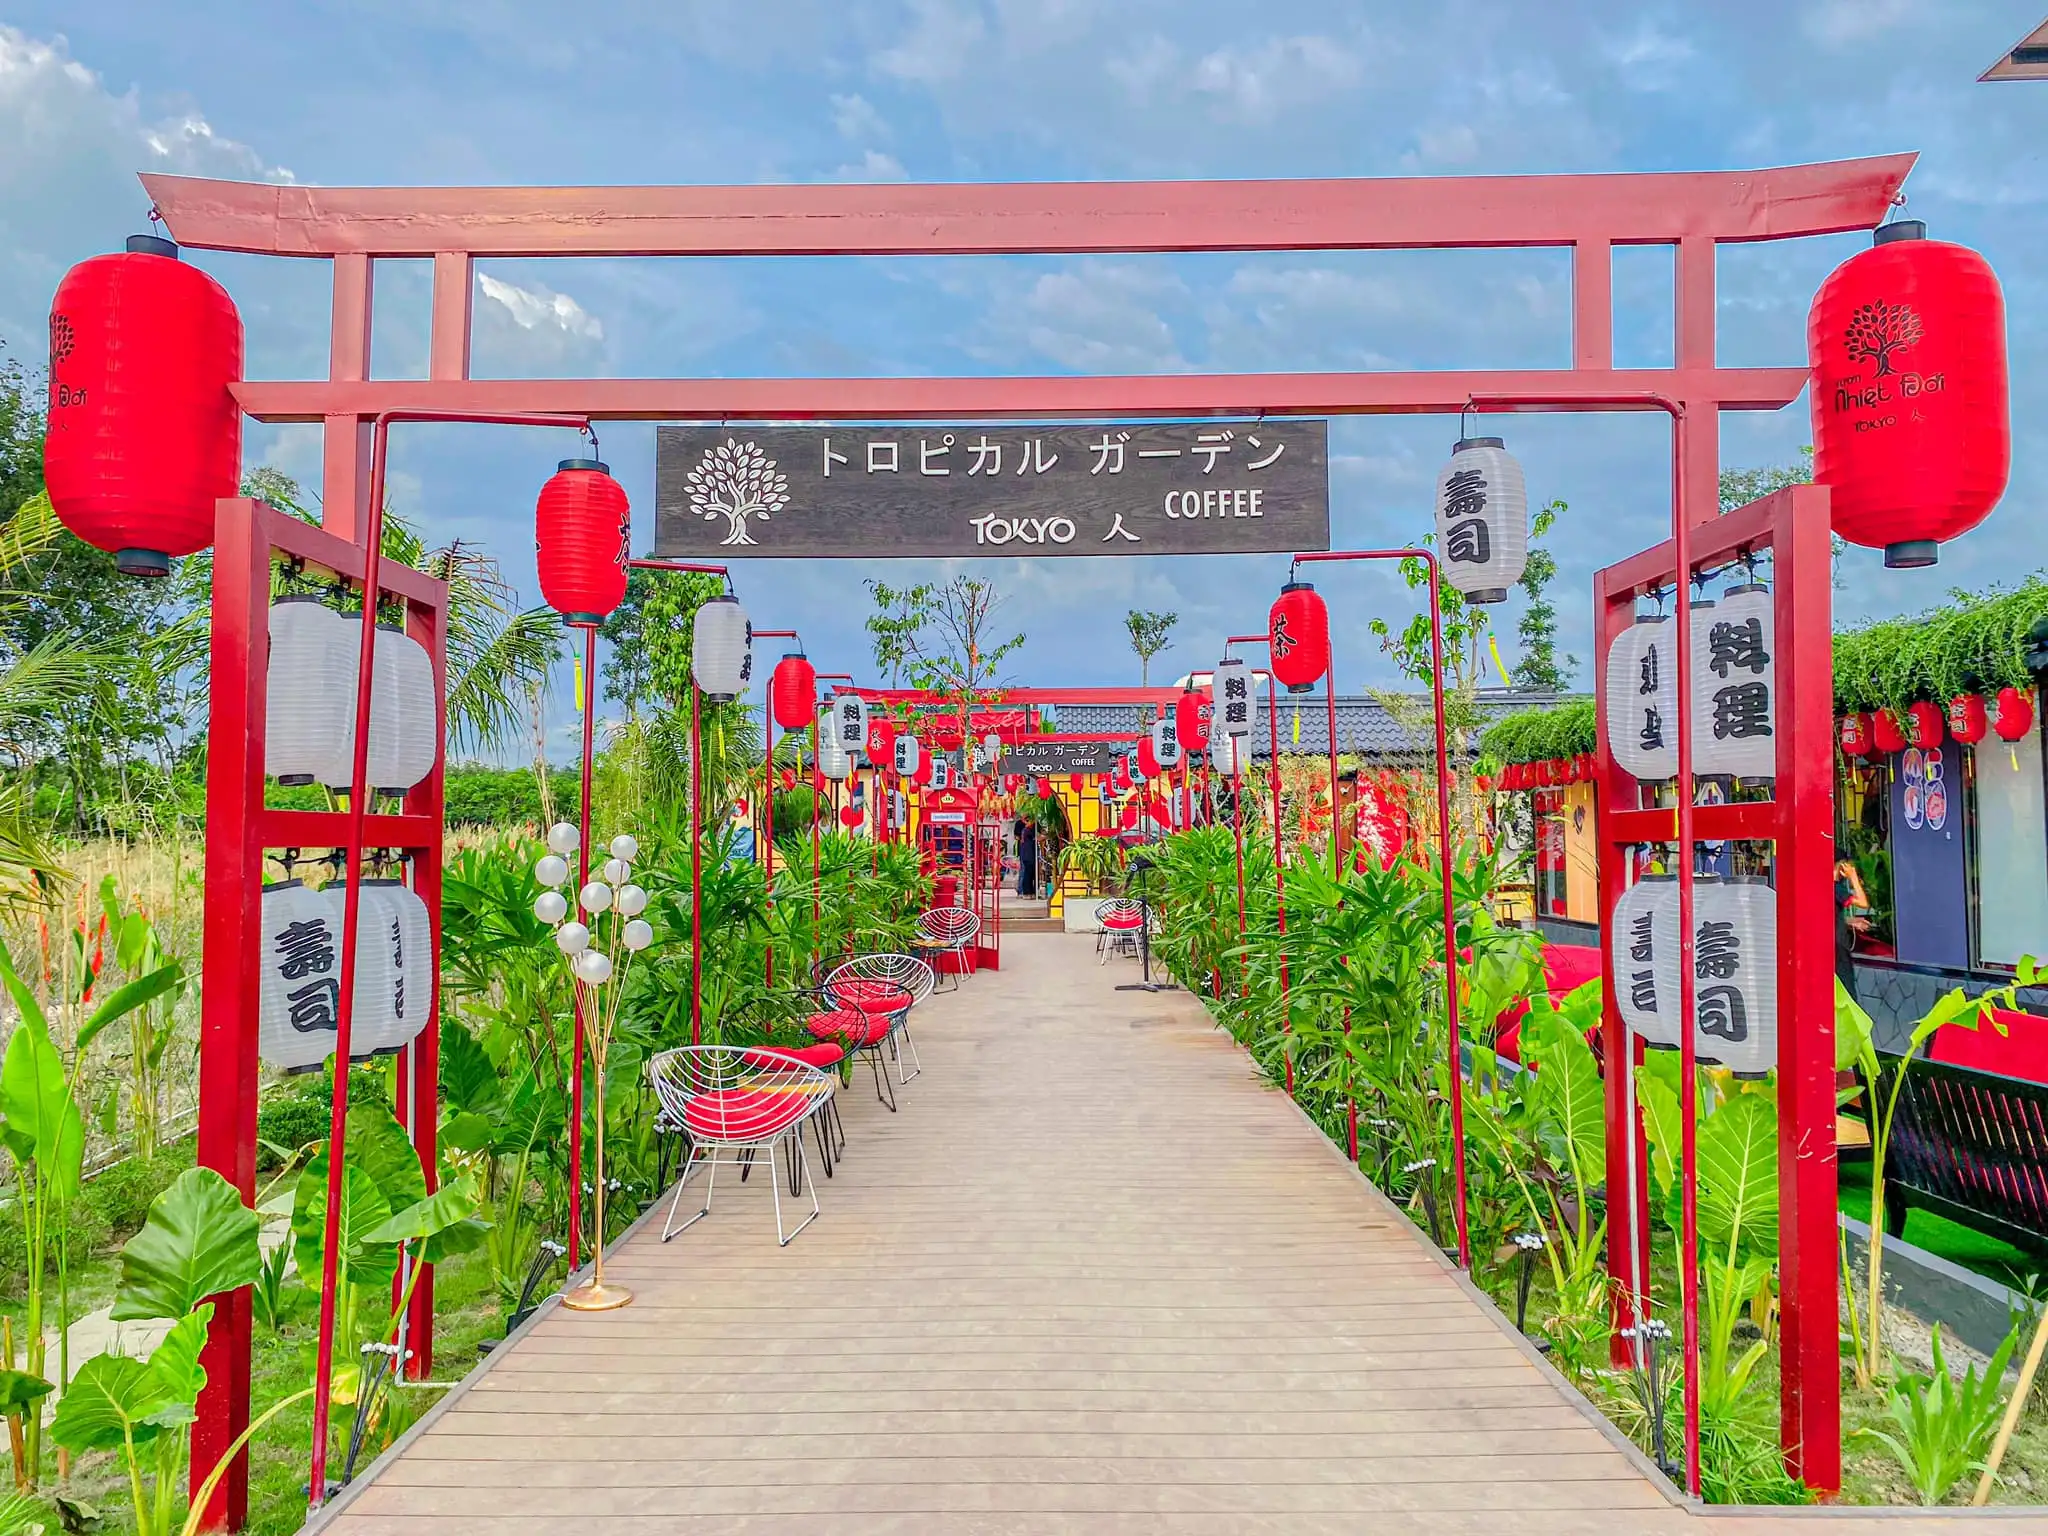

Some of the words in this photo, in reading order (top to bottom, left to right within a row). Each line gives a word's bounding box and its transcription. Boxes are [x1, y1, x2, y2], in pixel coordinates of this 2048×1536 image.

[1853, 416, 1896, 432] TOKYO
[822, 433, 1058, 478] トロピカル
[1089, 430, 1286, 477] ガーデン
[1164, 489, 1264, 519] COFFEE
[968, 512, 1077, 545] TOKYO
[1102, 513, 1141, 543] 人
[1710, 618, 1772, 740] 料理
[1225, 677, 1247, 723] 料理
[843, 703, 861, 741] 料理
[1004, 745, 1048, 756] ロピカル
[1054, 745, 1100, 756] ガーデン
[1161, 726, 1177, 758] 料理
[1027, 763, 1053, 772] TOKYO
[1071, 758, 1096, 766] COFFEE
